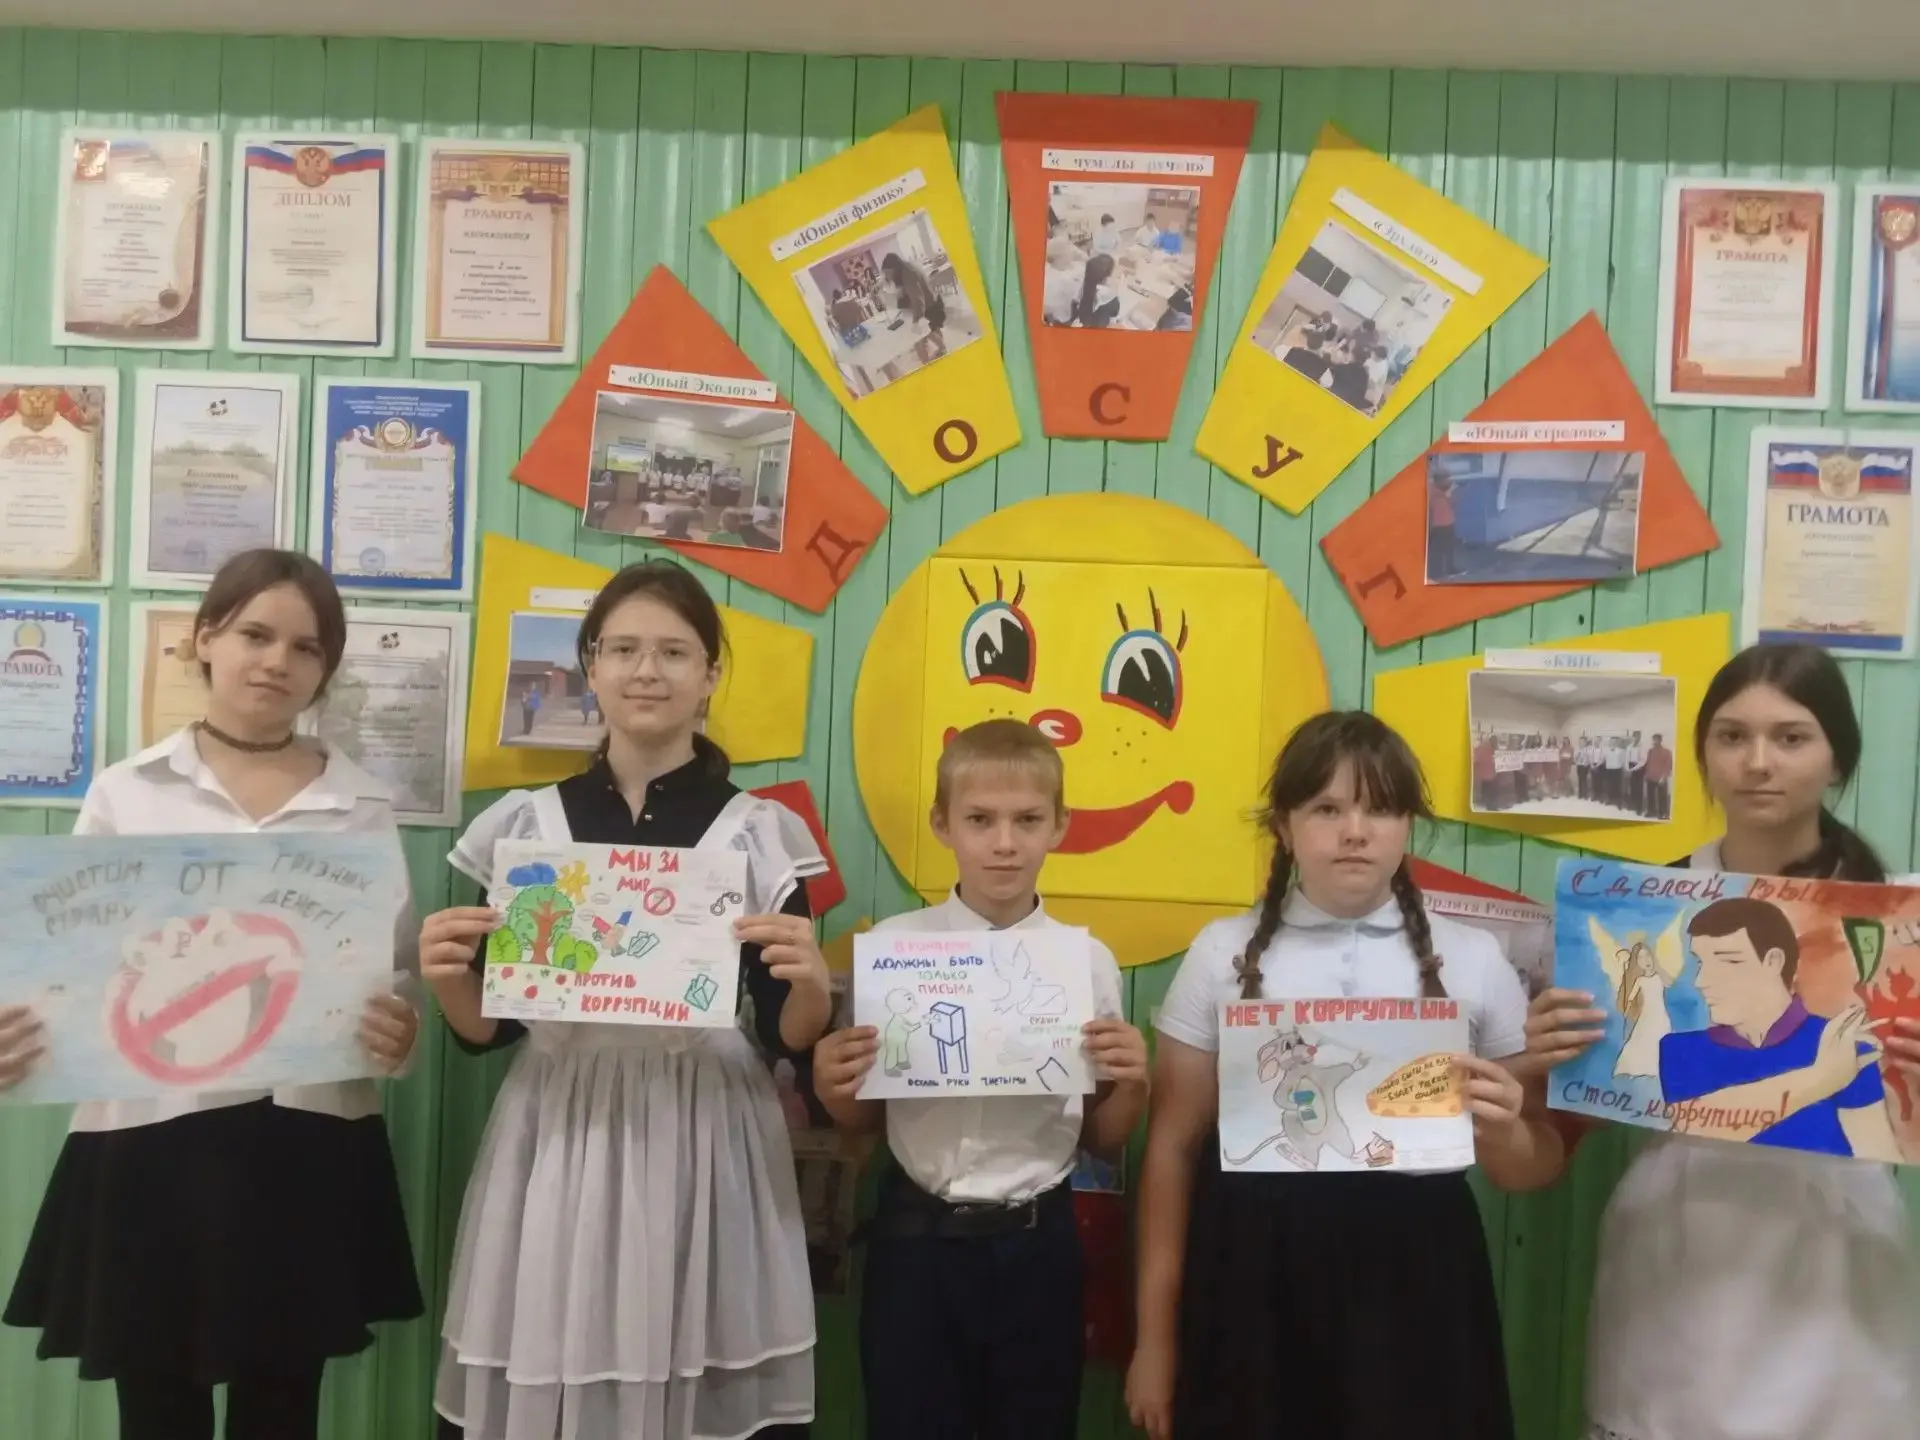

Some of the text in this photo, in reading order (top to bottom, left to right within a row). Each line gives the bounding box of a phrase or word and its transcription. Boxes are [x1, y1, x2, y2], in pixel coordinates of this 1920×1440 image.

[273, 191, 353, 208] ДИПЛОМ
[462, 207, 535, 222] ГРАМОТА
[793, 186, 904, 249] «Юный физик»
[1715, 249, 1789, 264] ГРАМОТА
[628, 371, 758, 397] «Юный Эколог»
[1089, 383, 1131, 425] С
[933, 420, 978, 463] О
[1466, 424, 1609, 442] «Юный стрелок»
[1251, 434, 1304, 479] У
[1786, 503, 1891, 529] ГРАМОТА
[804, 519, 867, 586] Д
[1353, 564, 1408, 601] Г
[657, 850, 679, 873] ЗА
[179, 860, 236, 895] ОТ
[1571, 865, 1726, 901] Сделай
[872, 955, 984, 971] ДОЛЖНЫ БЫТЬ
[918, 970, 968, 981] ТОЛЬКО
[574, 973, 637, 989] ПРОТИВ
[917, 983, 974, 996] ПИСЬМА
[580, 994, 690, 1022] КОРРУПЦИИ
[1226, 1000, 1458, 1028] НЕТ КОРРУПЦИИ
[1052, 1037, 1073, 1050] НЕТ
[946, 1078, 970, 1087] РУКИ
